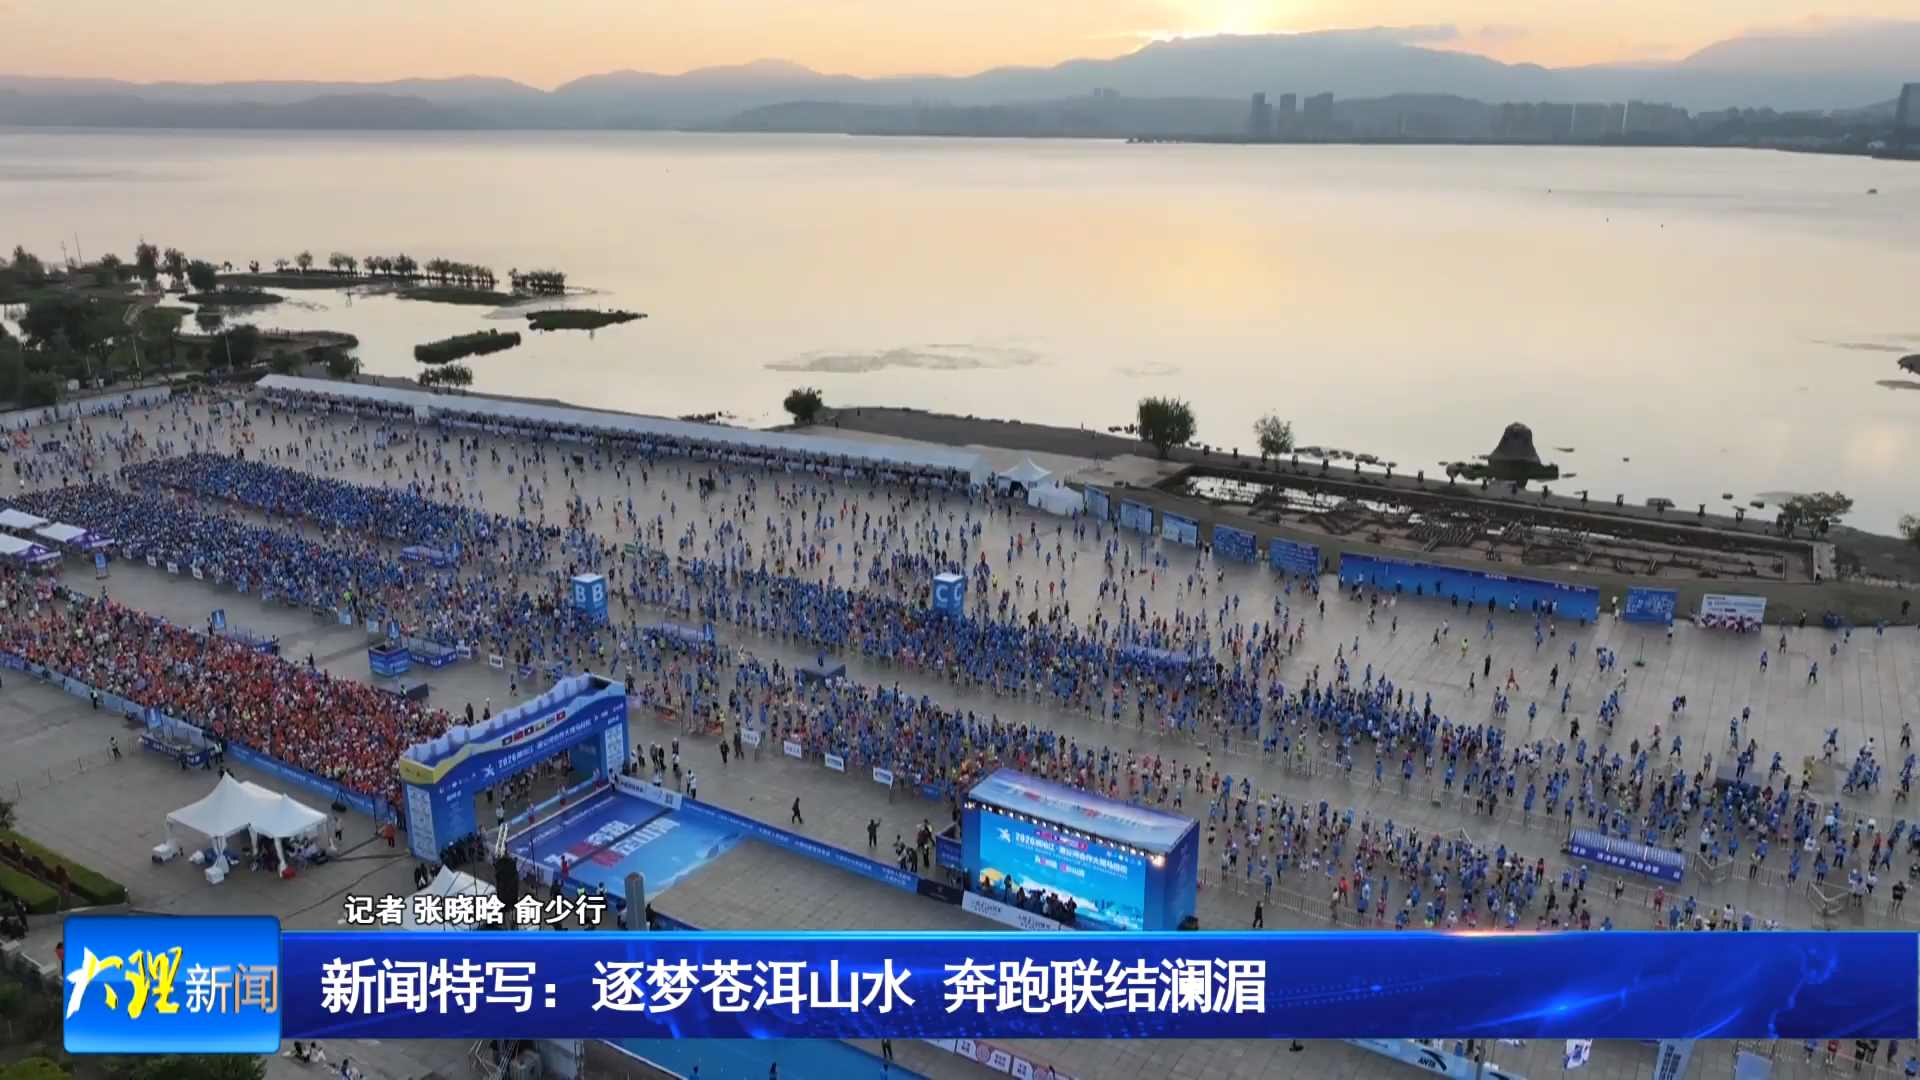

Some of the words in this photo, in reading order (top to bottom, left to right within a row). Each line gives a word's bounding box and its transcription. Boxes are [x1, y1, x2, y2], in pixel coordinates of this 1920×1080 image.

[575, 584, 586, 603] B
[591, 583, 604, 603] B
[935, 584, 949, 603] C
[954, 583, 962, 601] C
[1417, 1055, 1436, 1069] ANTA
